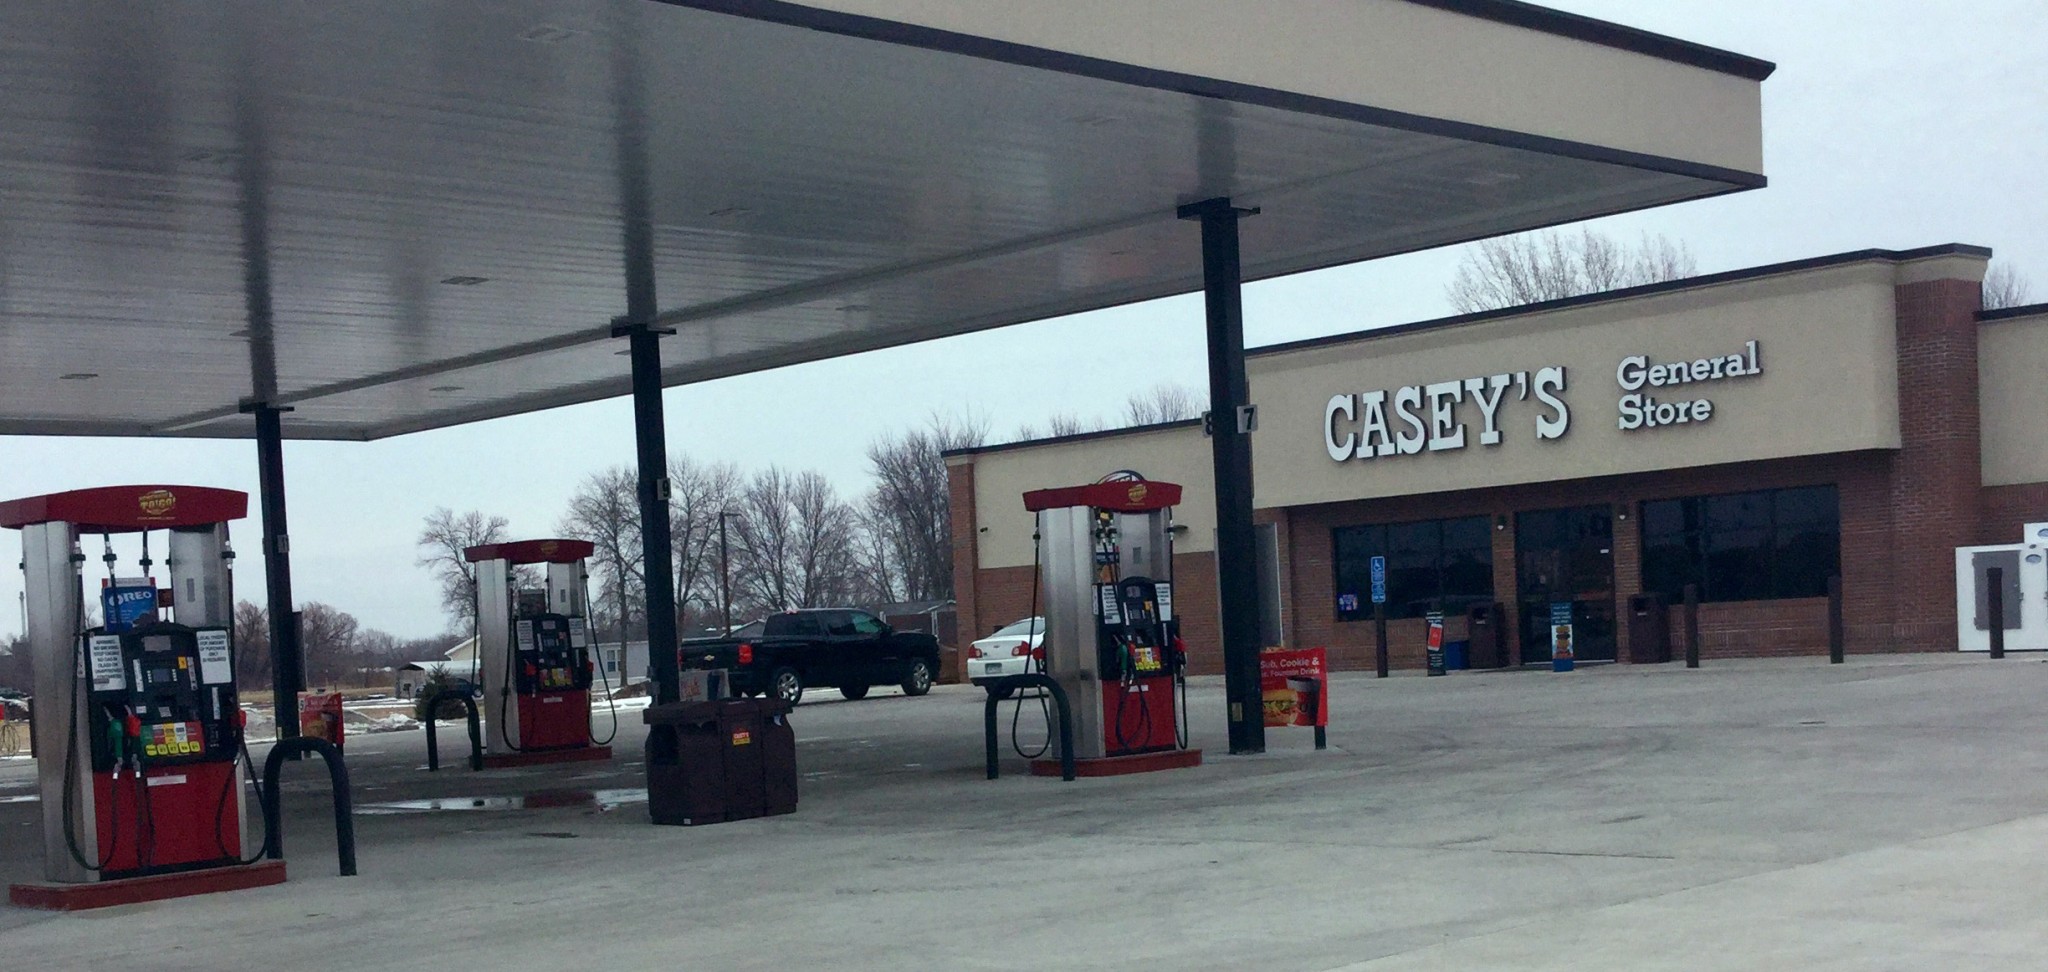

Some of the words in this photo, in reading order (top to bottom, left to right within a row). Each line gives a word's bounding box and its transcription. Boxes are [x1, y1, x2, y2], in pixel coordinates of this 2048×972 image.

[1616, 340, 1761, 391] General
[1243, 407, 1255, 430] 7
[1324, 366, 1570, 462] CASEY'S
[1618, 393, 1712, 430] Store
[108, 591, 152, 607] OREO
[1280, 657, 1310, 667] Cookie
[1312, 656, 1320, 666] &
[1300, 667, 1320, 675] Drink
